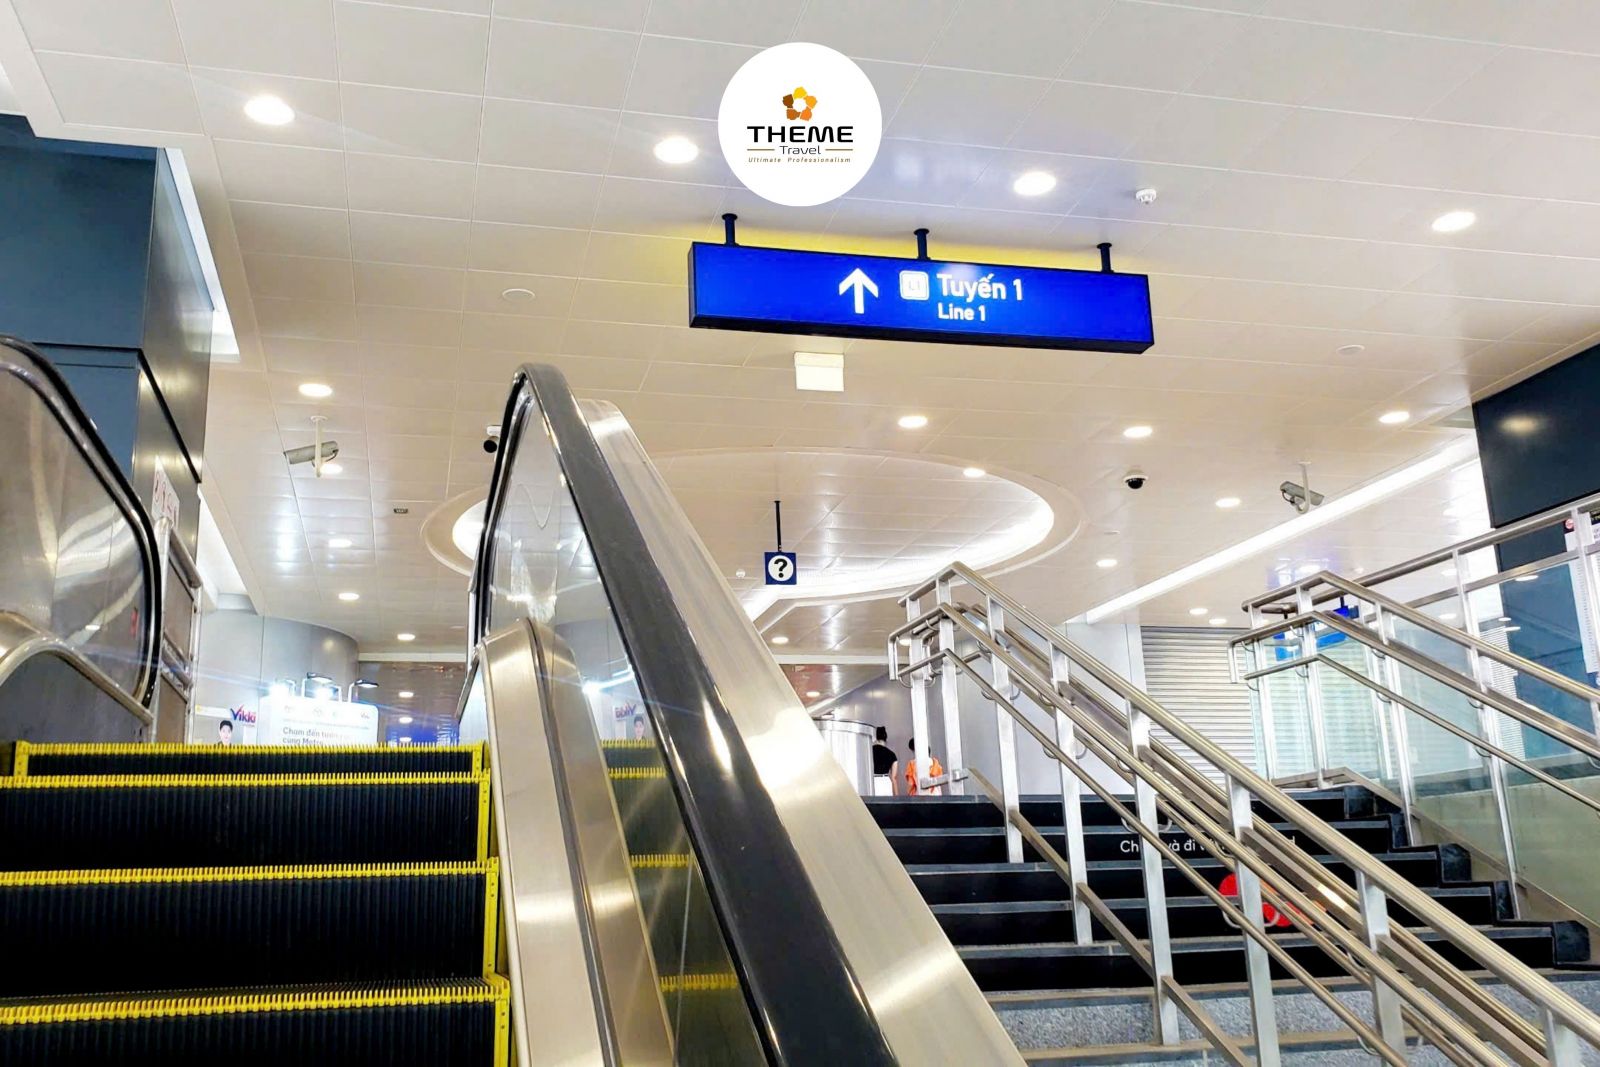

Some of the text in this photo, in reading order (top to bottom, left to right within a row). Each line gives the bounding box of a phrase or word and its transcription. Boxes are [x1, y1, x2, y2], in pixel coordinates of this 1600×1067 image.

[936, 273, 1023, 303] Tuyến 1
[938, 302, 986, 321] Line 1
[1183, 838, 1196, 852] đi
